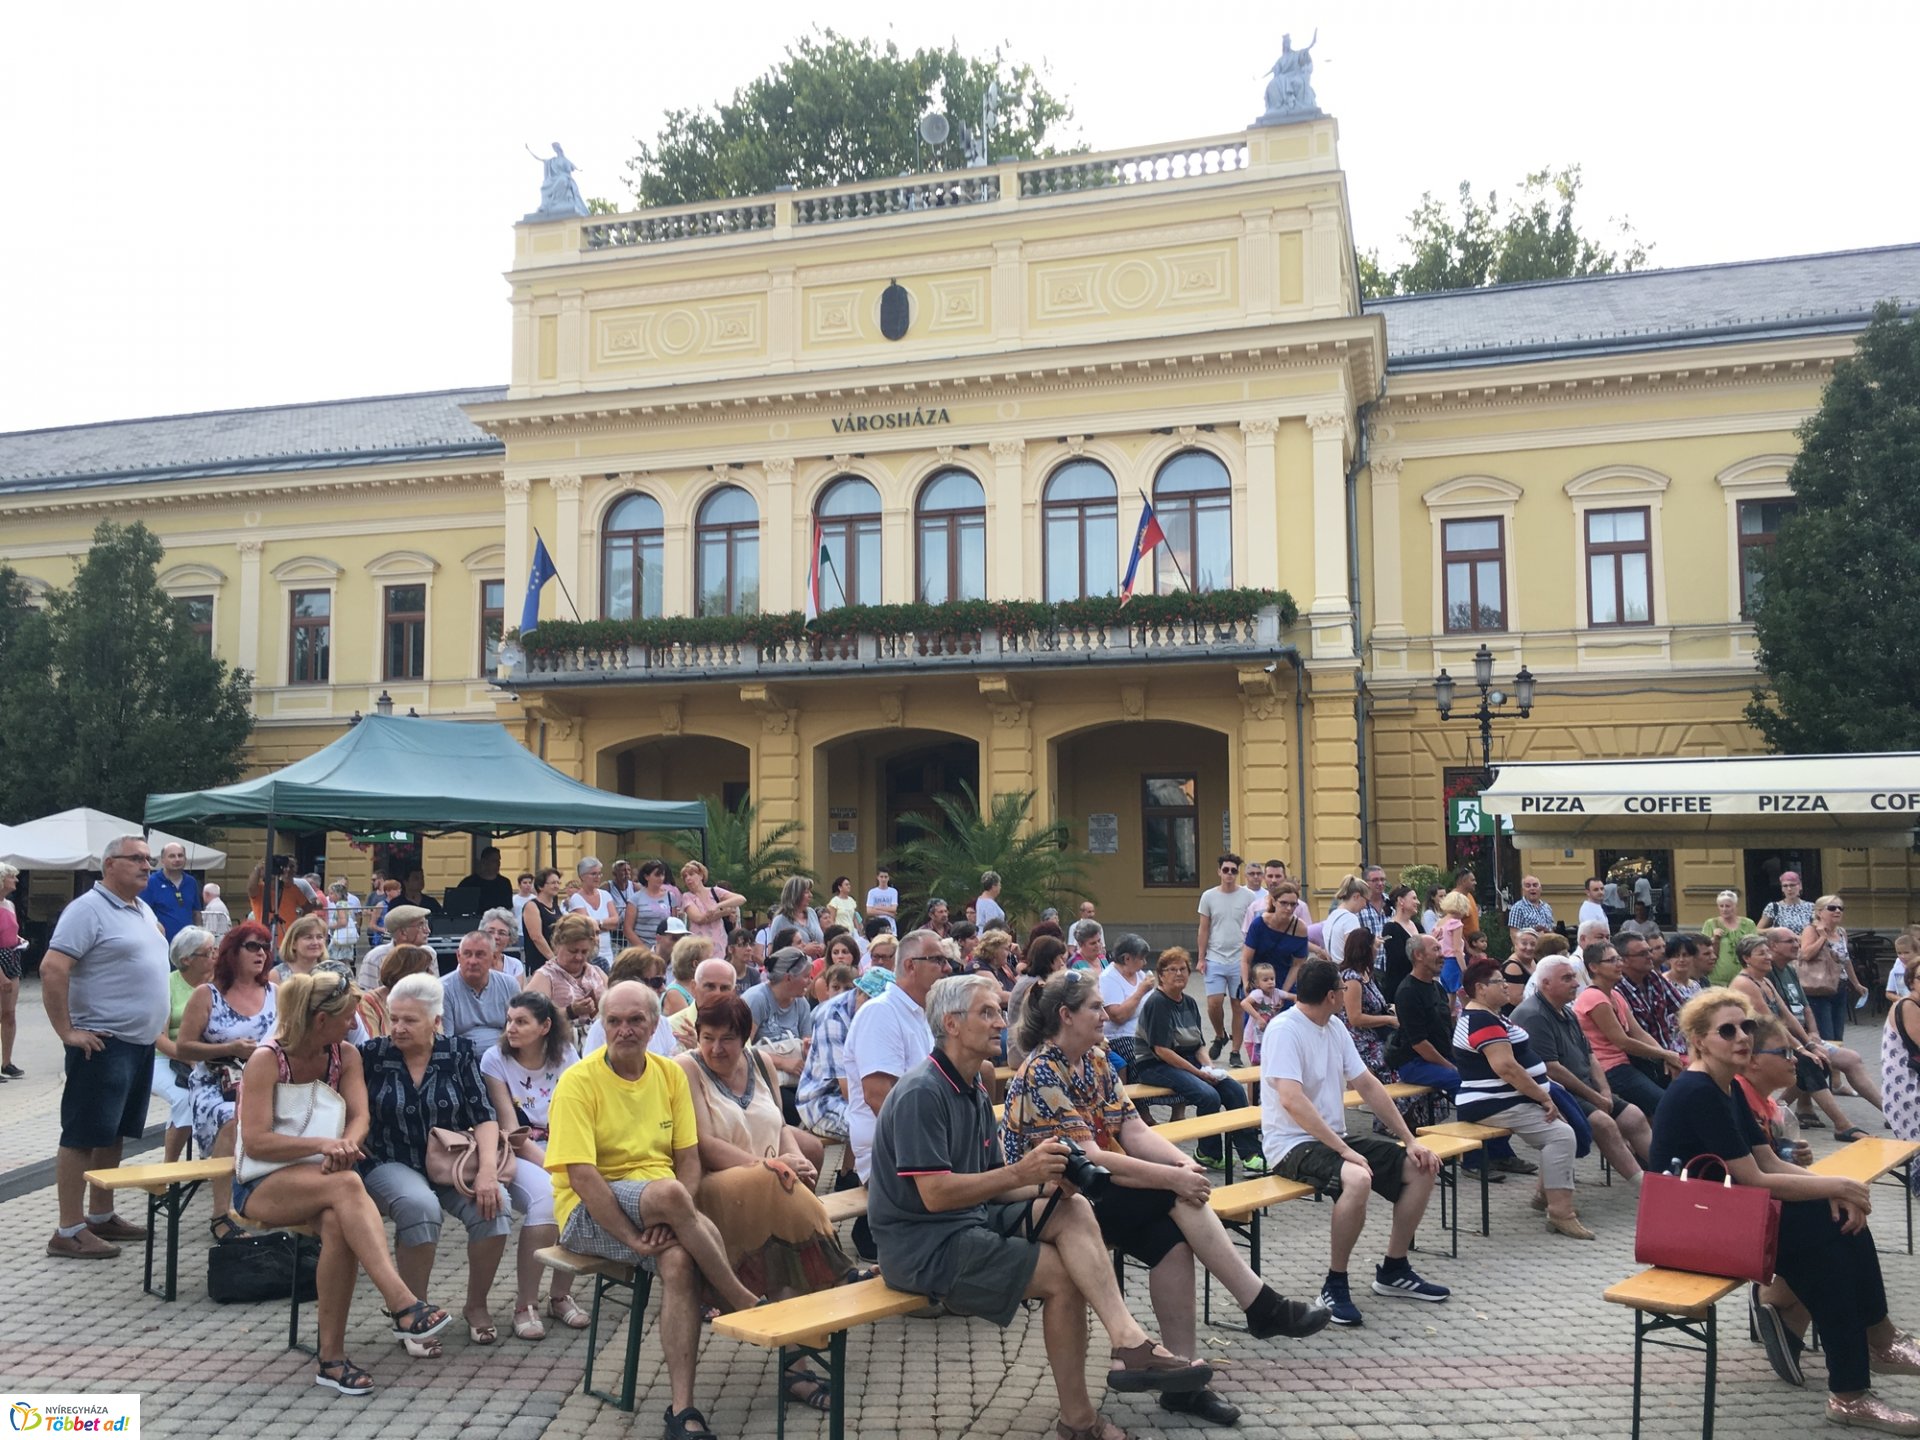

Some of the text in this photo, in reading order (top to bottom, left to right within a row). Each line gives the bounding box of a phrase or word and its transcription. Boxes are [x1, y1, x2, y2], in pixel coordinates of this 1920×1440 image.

[831, 406, 951, 433] VÁROSHÁZA
[1521, 793, 1920, 813] PIZZA COFFEE PIZZA COF
